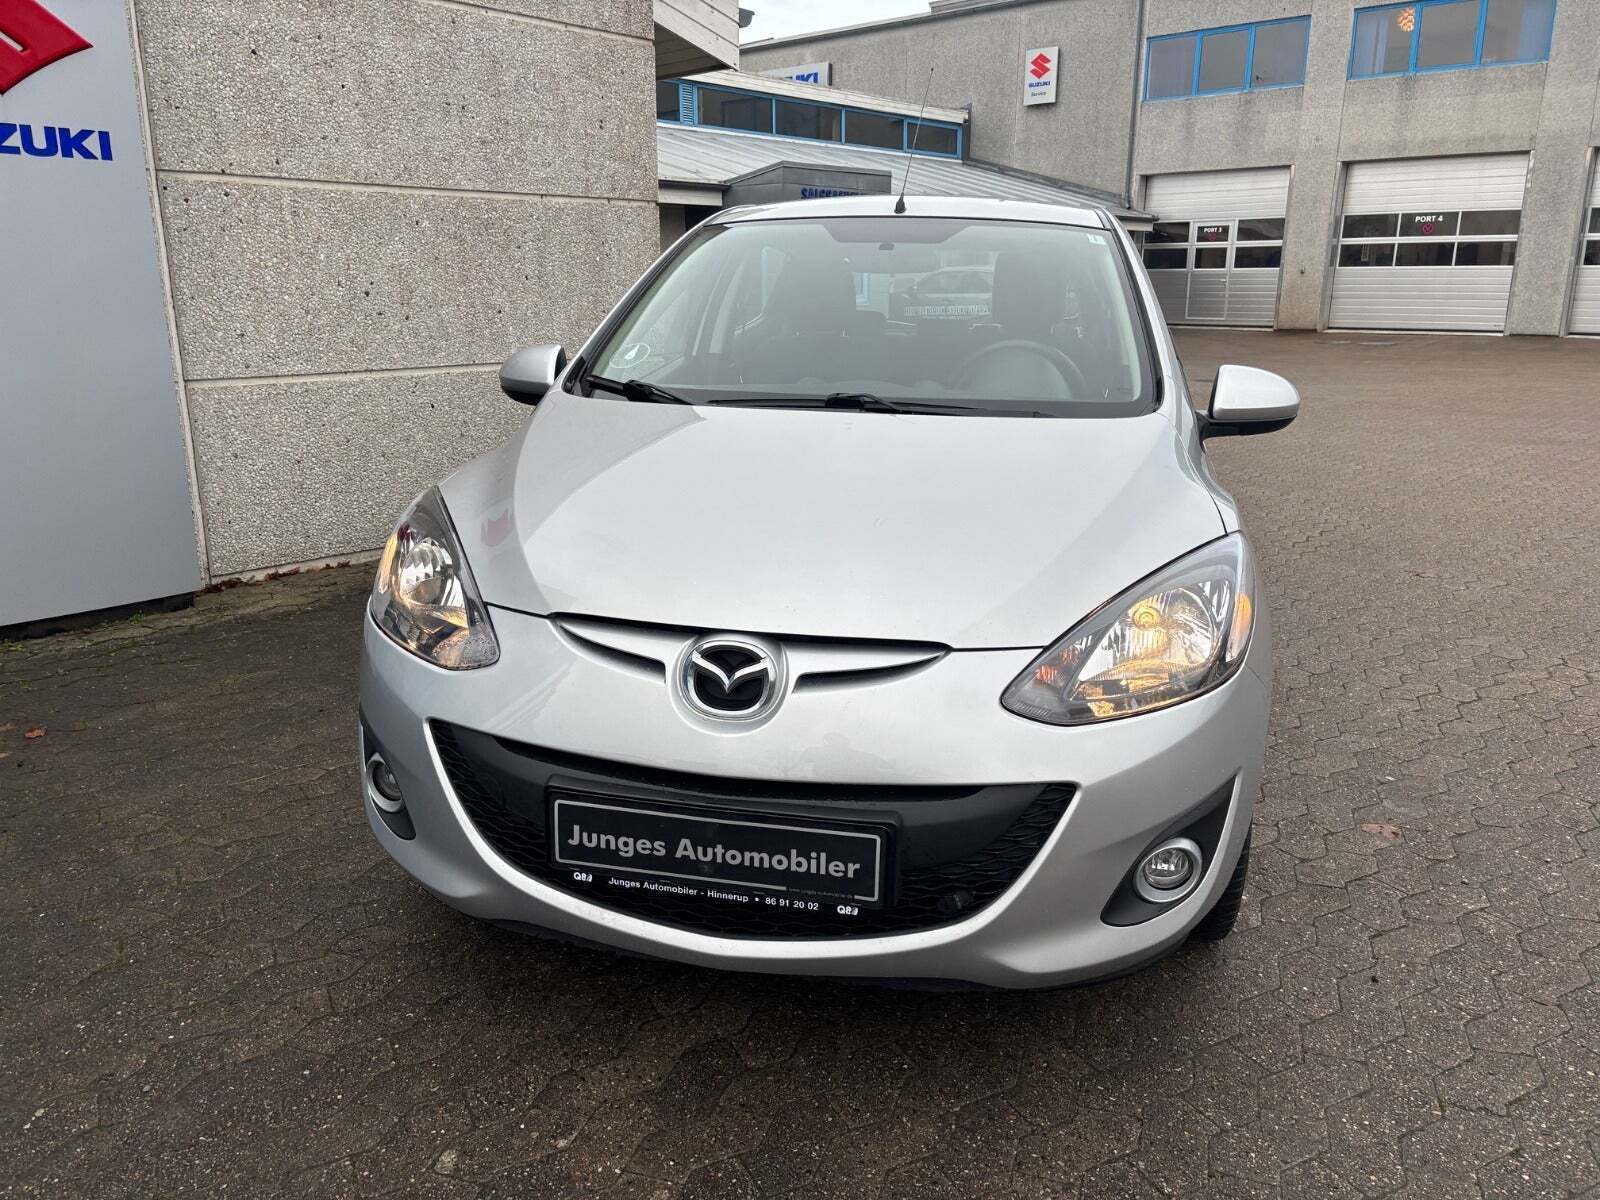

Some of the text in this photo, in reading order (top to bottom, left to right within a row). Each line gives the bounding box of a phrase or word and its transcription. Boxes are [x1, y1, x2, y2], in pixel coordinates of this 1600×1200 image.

[0, 122, 113, 161] ZUKI
[1414, 214, 1444, 223] PORT 4
[568, 825, 860, 878] Junges Automobiler
[608, 877, 641, 888] Junges
[643, 881, 698, 896] Automobiler
[707, 889, 749, 903] Hinnerup
[765, 896, 777, 906] 86
[779, 898, 790, 907] 91
[793, 900, 805, 909] 20
[807, 902, 819, 911] 02
